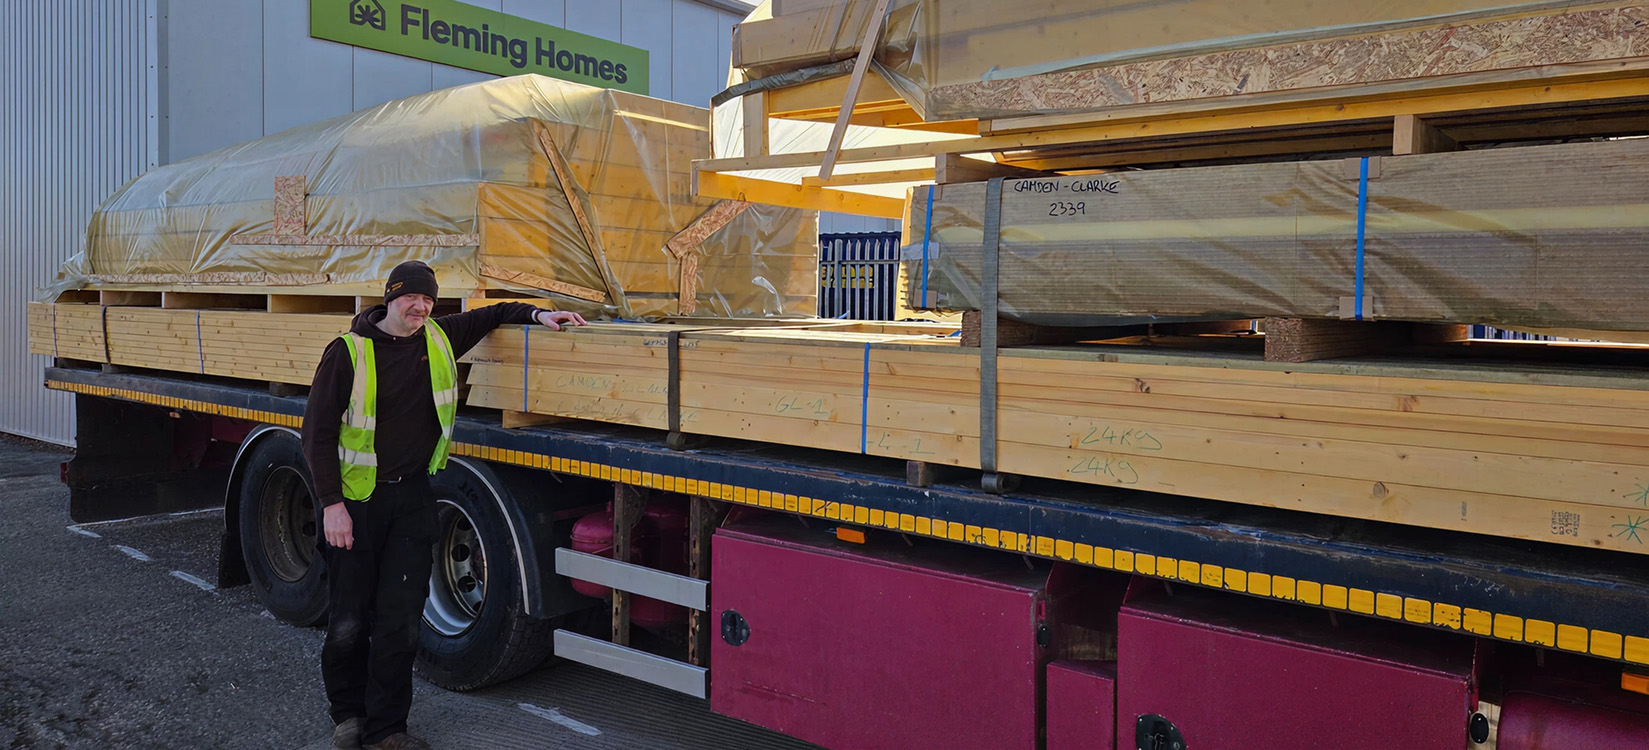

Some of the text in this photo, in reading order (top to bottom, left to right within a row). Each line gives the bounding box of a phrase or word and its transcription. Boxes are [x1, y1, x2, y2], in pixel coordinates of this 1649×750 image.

[400, 2, 628, 84] Fleming Homes
[1014, 180, 1060, 193] CAMDEN
[1071, 180, 1120, 194] CLARKE
[1048, 202, 1086, 216] 2339
